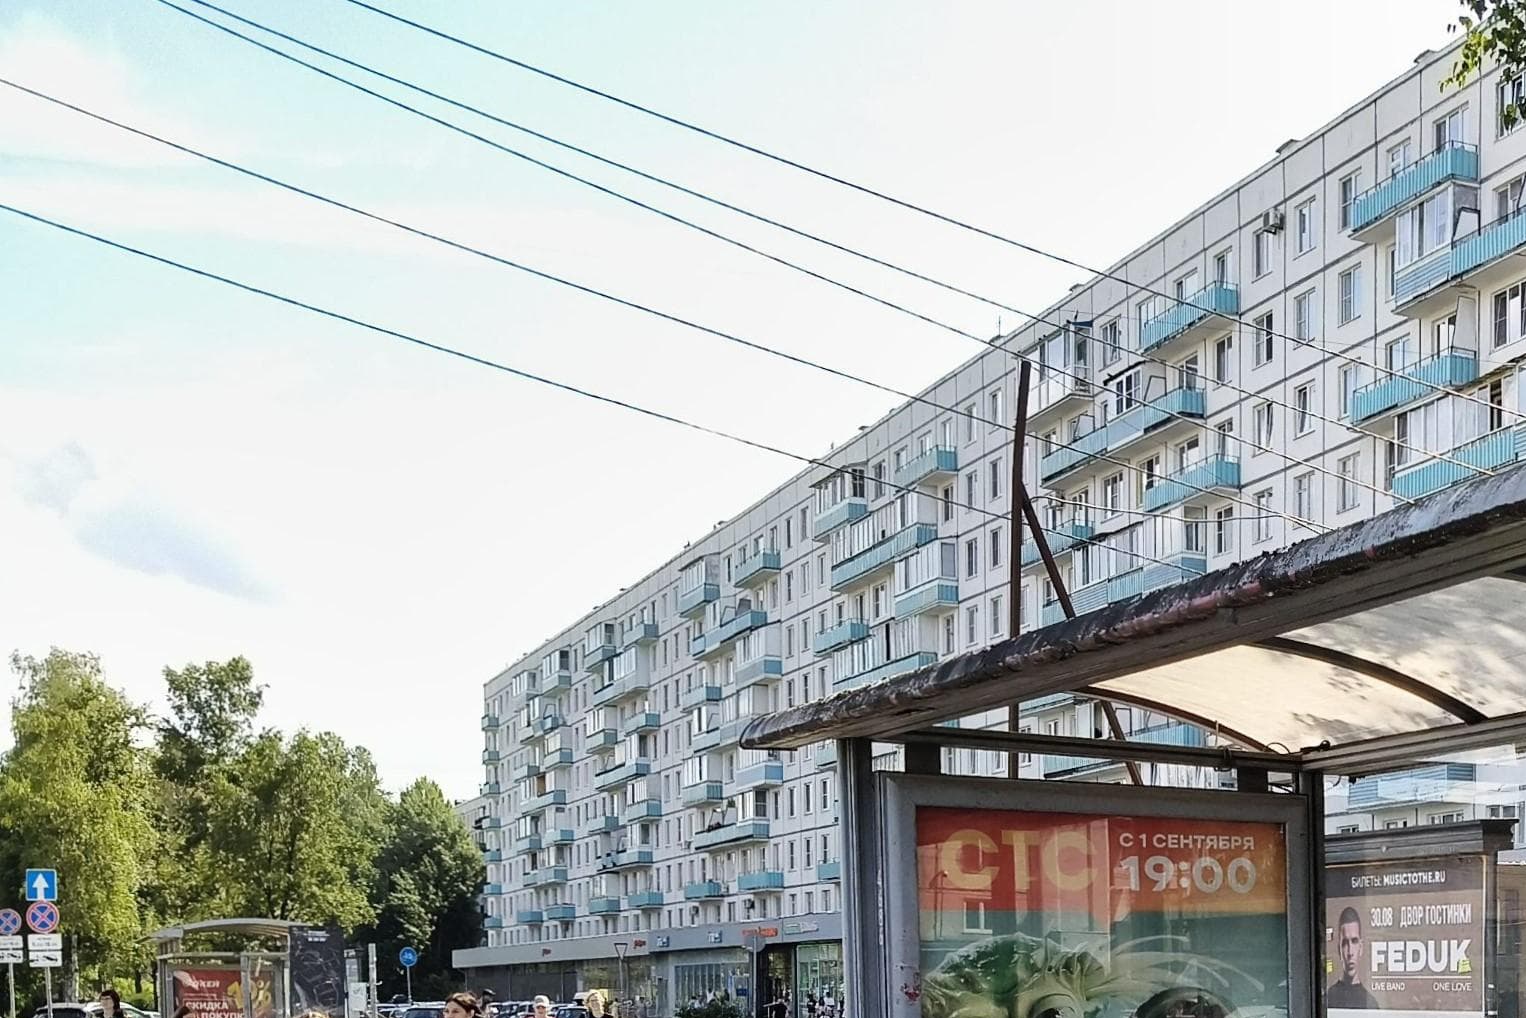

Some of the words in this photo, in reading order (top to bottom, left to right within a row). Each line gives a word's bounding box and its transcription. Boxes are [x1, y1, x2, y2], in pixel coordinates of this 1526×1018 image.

[1119, 832, 1133, 847] С
[1139, 832, 1148, 848] 1
[1153, 834, 1254, 850] СЕНТЯБРЯ
[939, 829, 1099, 891] СТС
[1120, 857, 1257, 893] 19:00
[1351, 875, 1382, 889] БИЛЕТЫ:
[1383, 870, 1446, 886] MUSICTOTHE.RU
[1370, 908, 1393, 928] 30.08
[1399, 906, 1424, 928] ДВОР
[1425, 903, 1472, 925] ГОСТИНКИ
[1371, 939, 1472, 973] FEDUK
[1371, 983, 1386, 991] LIVE
[1387, 983, 1406, 991] BAND
[1432, 982, 1449, 992] ONE
[1452, 983, 1473, 992] LOVE
[185, 1001, 229, 1011] СКИДКА
